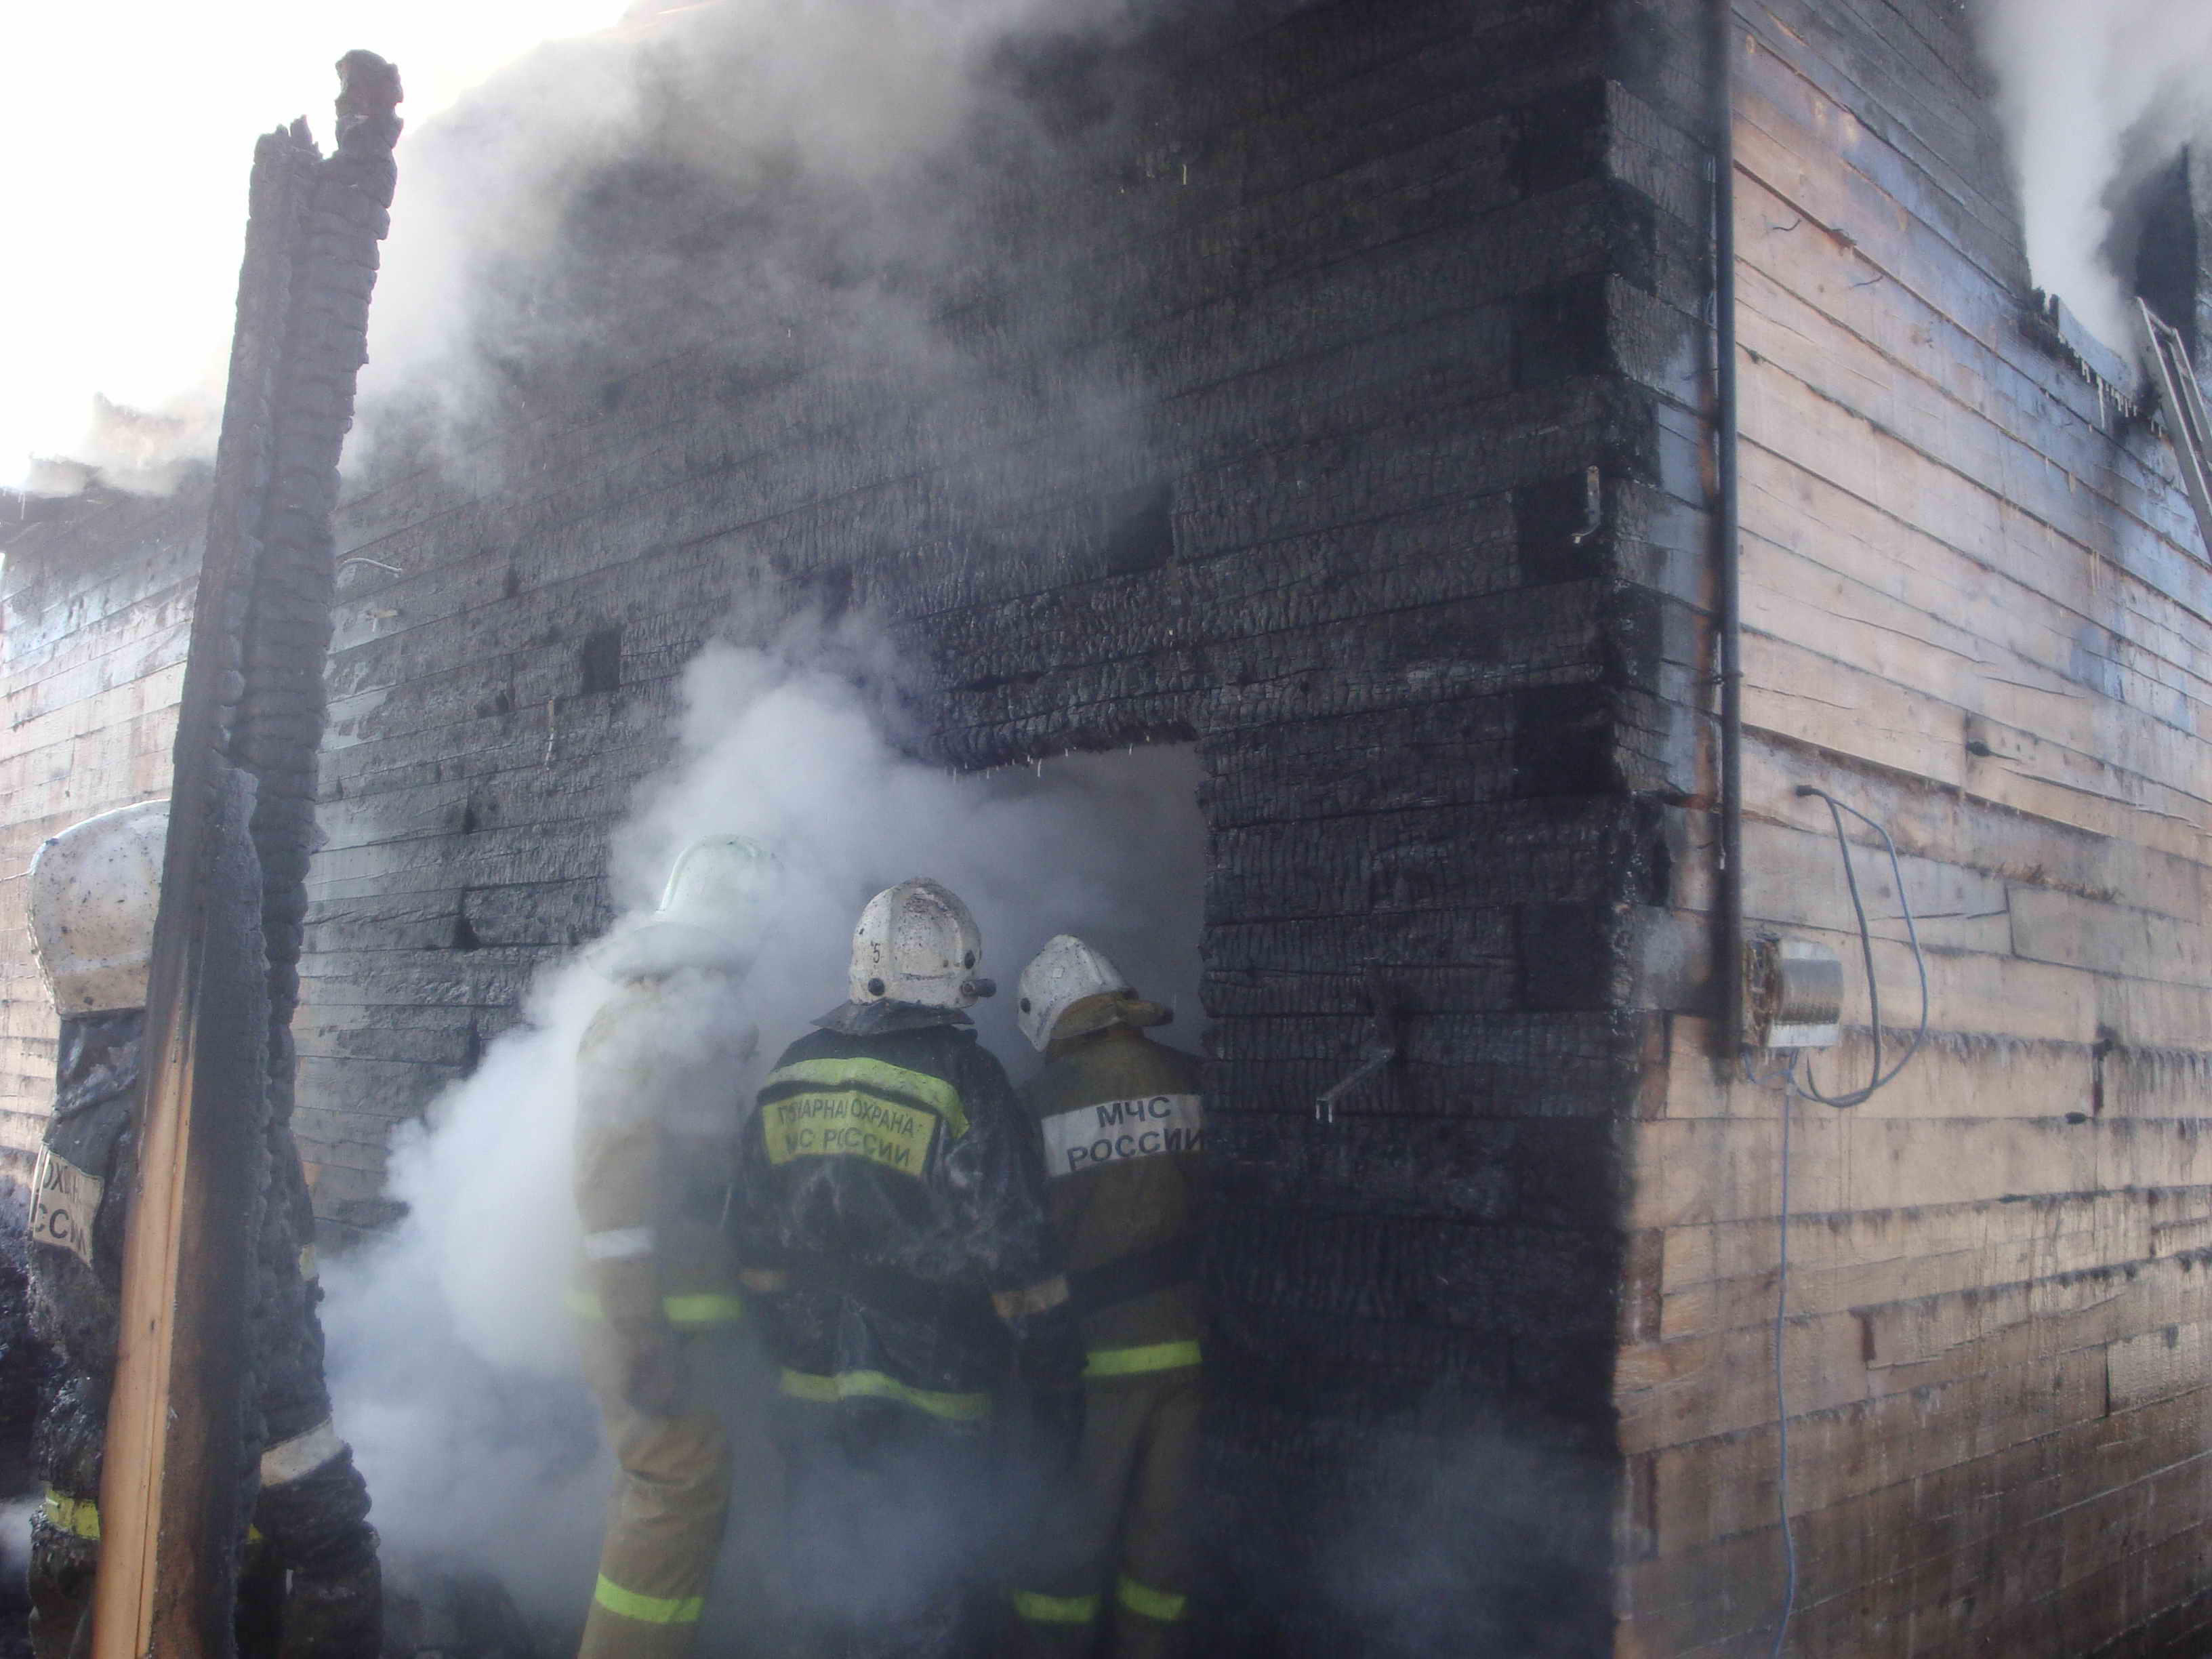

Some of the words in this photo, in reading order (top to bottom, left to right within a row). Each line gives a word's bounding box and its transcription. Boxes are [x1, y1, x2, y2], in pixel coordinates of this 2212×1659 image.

[851, 1098, 914, 1139] ОХРАНА
[1096, 1097, 1171, 1128] МЧС
[1067, 1128, 1204, 1171] РОССИИ
